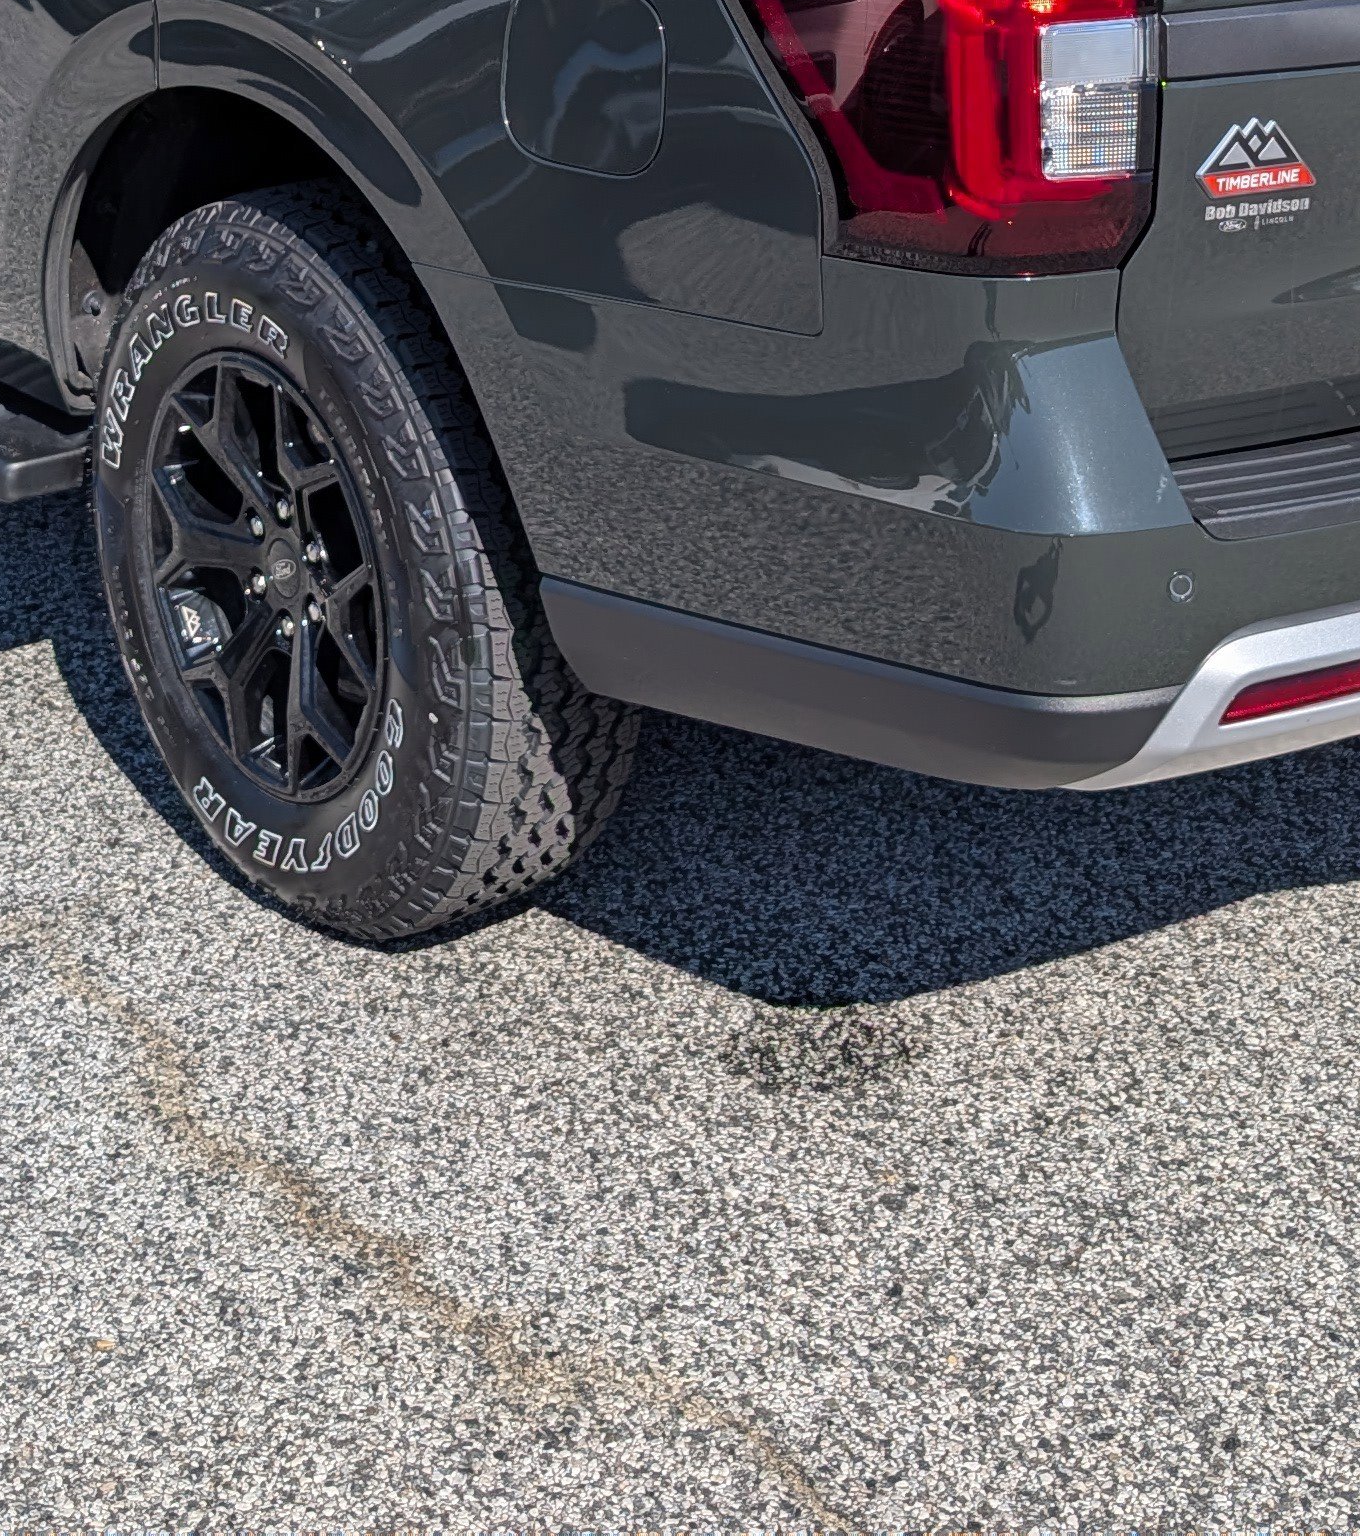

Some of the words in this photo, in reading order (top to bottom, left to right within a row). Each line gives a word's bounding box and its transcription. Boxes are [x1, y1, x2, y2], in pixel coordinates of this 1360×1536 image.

[1216, 168, 1300, 192] TIMBERLINE
[1204, 204, 1236, 221] Bob
[1238, 197, 1310, 217] Davidson
[1261, 215, 1295, 226] LINCOLN
[101, 291, 289, 470] WRANGLER
[192, 697, 404, 873] GOODYEAR
